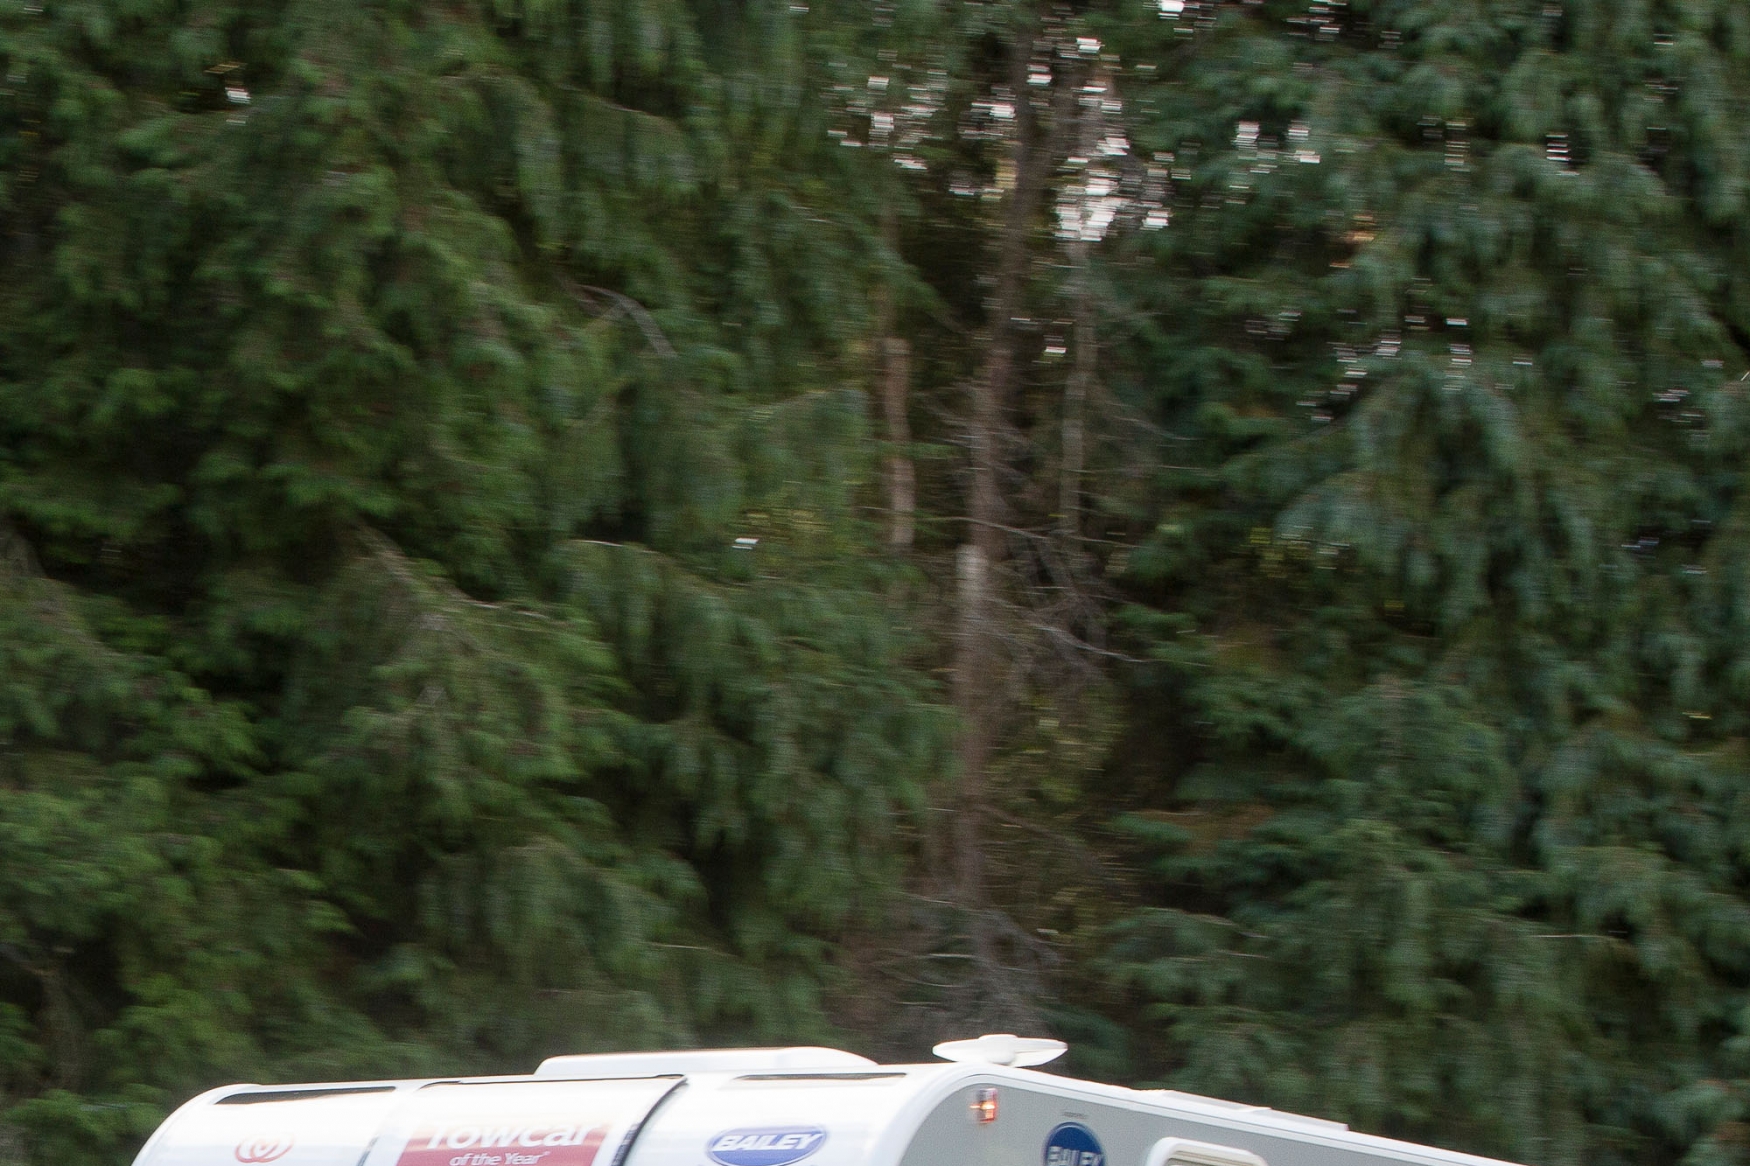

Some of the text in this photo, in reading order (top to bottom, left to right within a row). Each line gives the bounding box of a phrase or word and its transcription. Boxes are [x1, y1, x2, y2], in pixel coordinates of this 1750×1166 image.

[427, 1119, 602, 1149] Towcar
[711, 1133, 824, 1151] BAILEY
[449, 1152, 471, 1166] of
[472, 1152, 501, 1166] the
